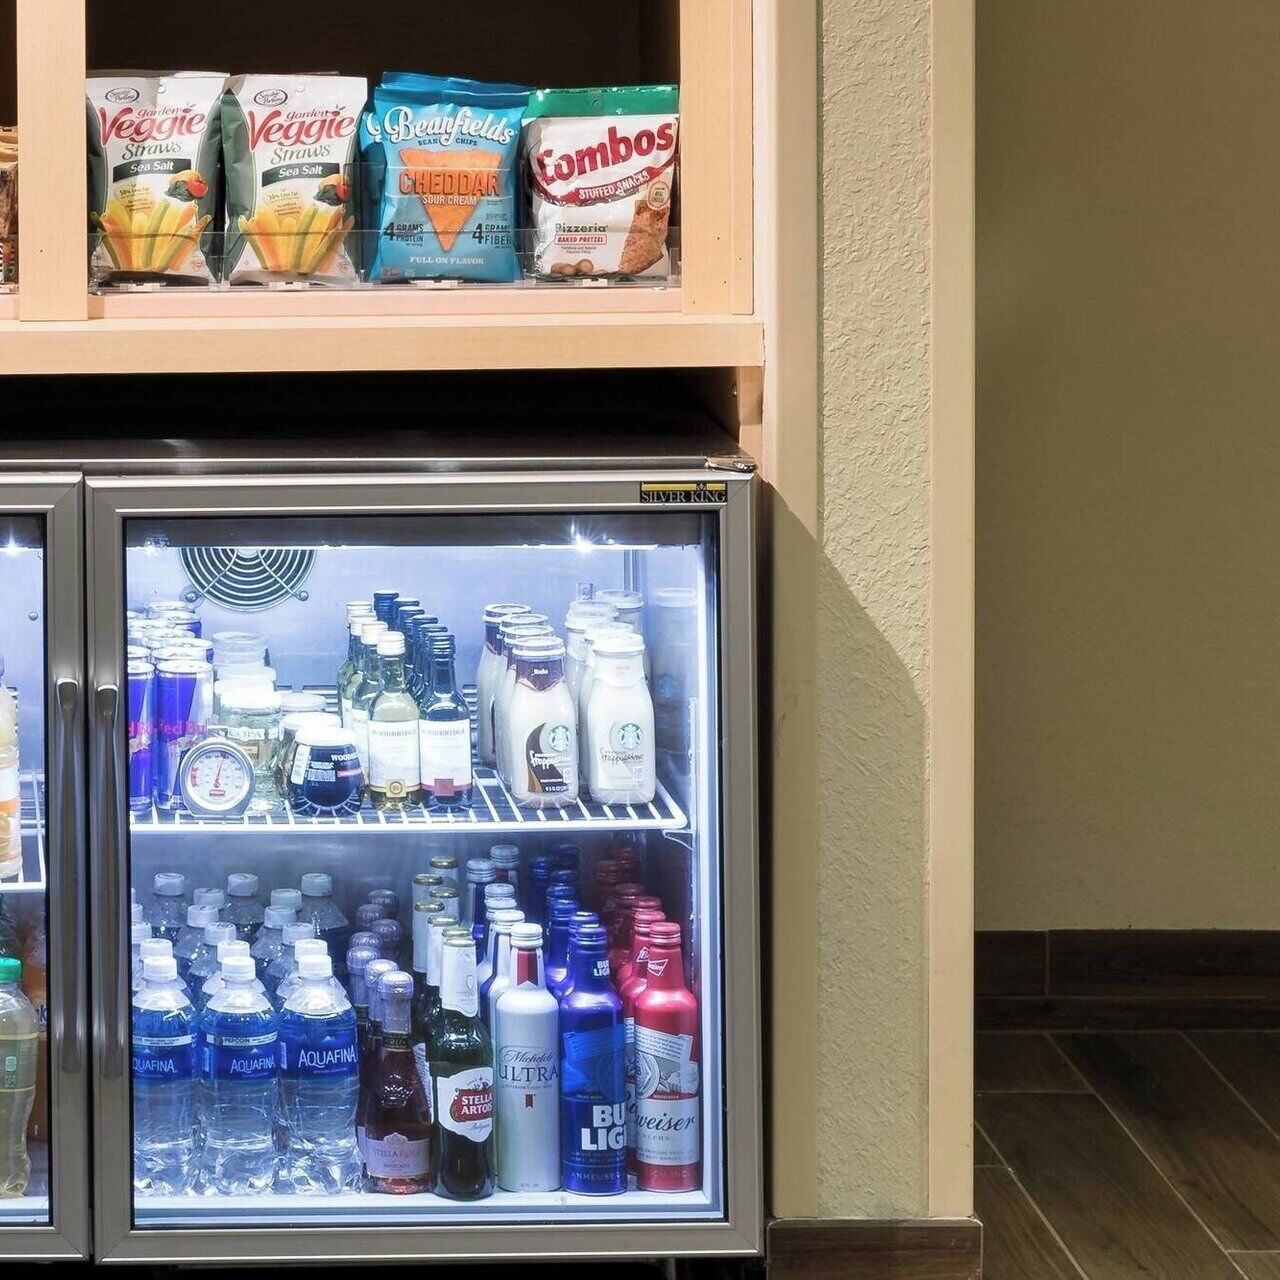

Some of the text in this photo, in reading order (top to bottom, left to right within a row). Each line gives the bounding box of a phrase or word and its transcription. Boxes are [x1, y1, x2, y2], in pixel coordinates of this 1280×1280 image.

[286, 109, 330, 121] garden
[99, 106, 207, 148] Veggie
[248, 110, 356, 152] Veggie
[384, 106, 515, 147] Beanfields
[121, 140, 182, 161] Straws
[270, 145, 331, 166] Straws
[536, 122, 675, 187] Combos
[130, 160, 174, 173] Sea Salt
[278, 165, 323, 179] Sea Salt
[399, 170, 501, 197] CHEDDAR
[578, 170, 650, 200] STUFFED SNACKS
[422, 195, 477, 206] SOUR CREAM
[383, 221, 396, 242] 4
[396, 223, 424, 233] GRAMS
[471, 222, 483, 245] 4
[555, 222, 606, 234] Pizzeria
[396, 233, 424, 244] PROTEIN
[484, 234, 512, 246] FIBER
[409, 256, 484, 265] FULL ON FLAVOR
[641, 491, 726, 503] SILVER KING
[298, 1044, 357, 1069] AQUAFINA
[499, 1065, 559, 1083] ULTRA
